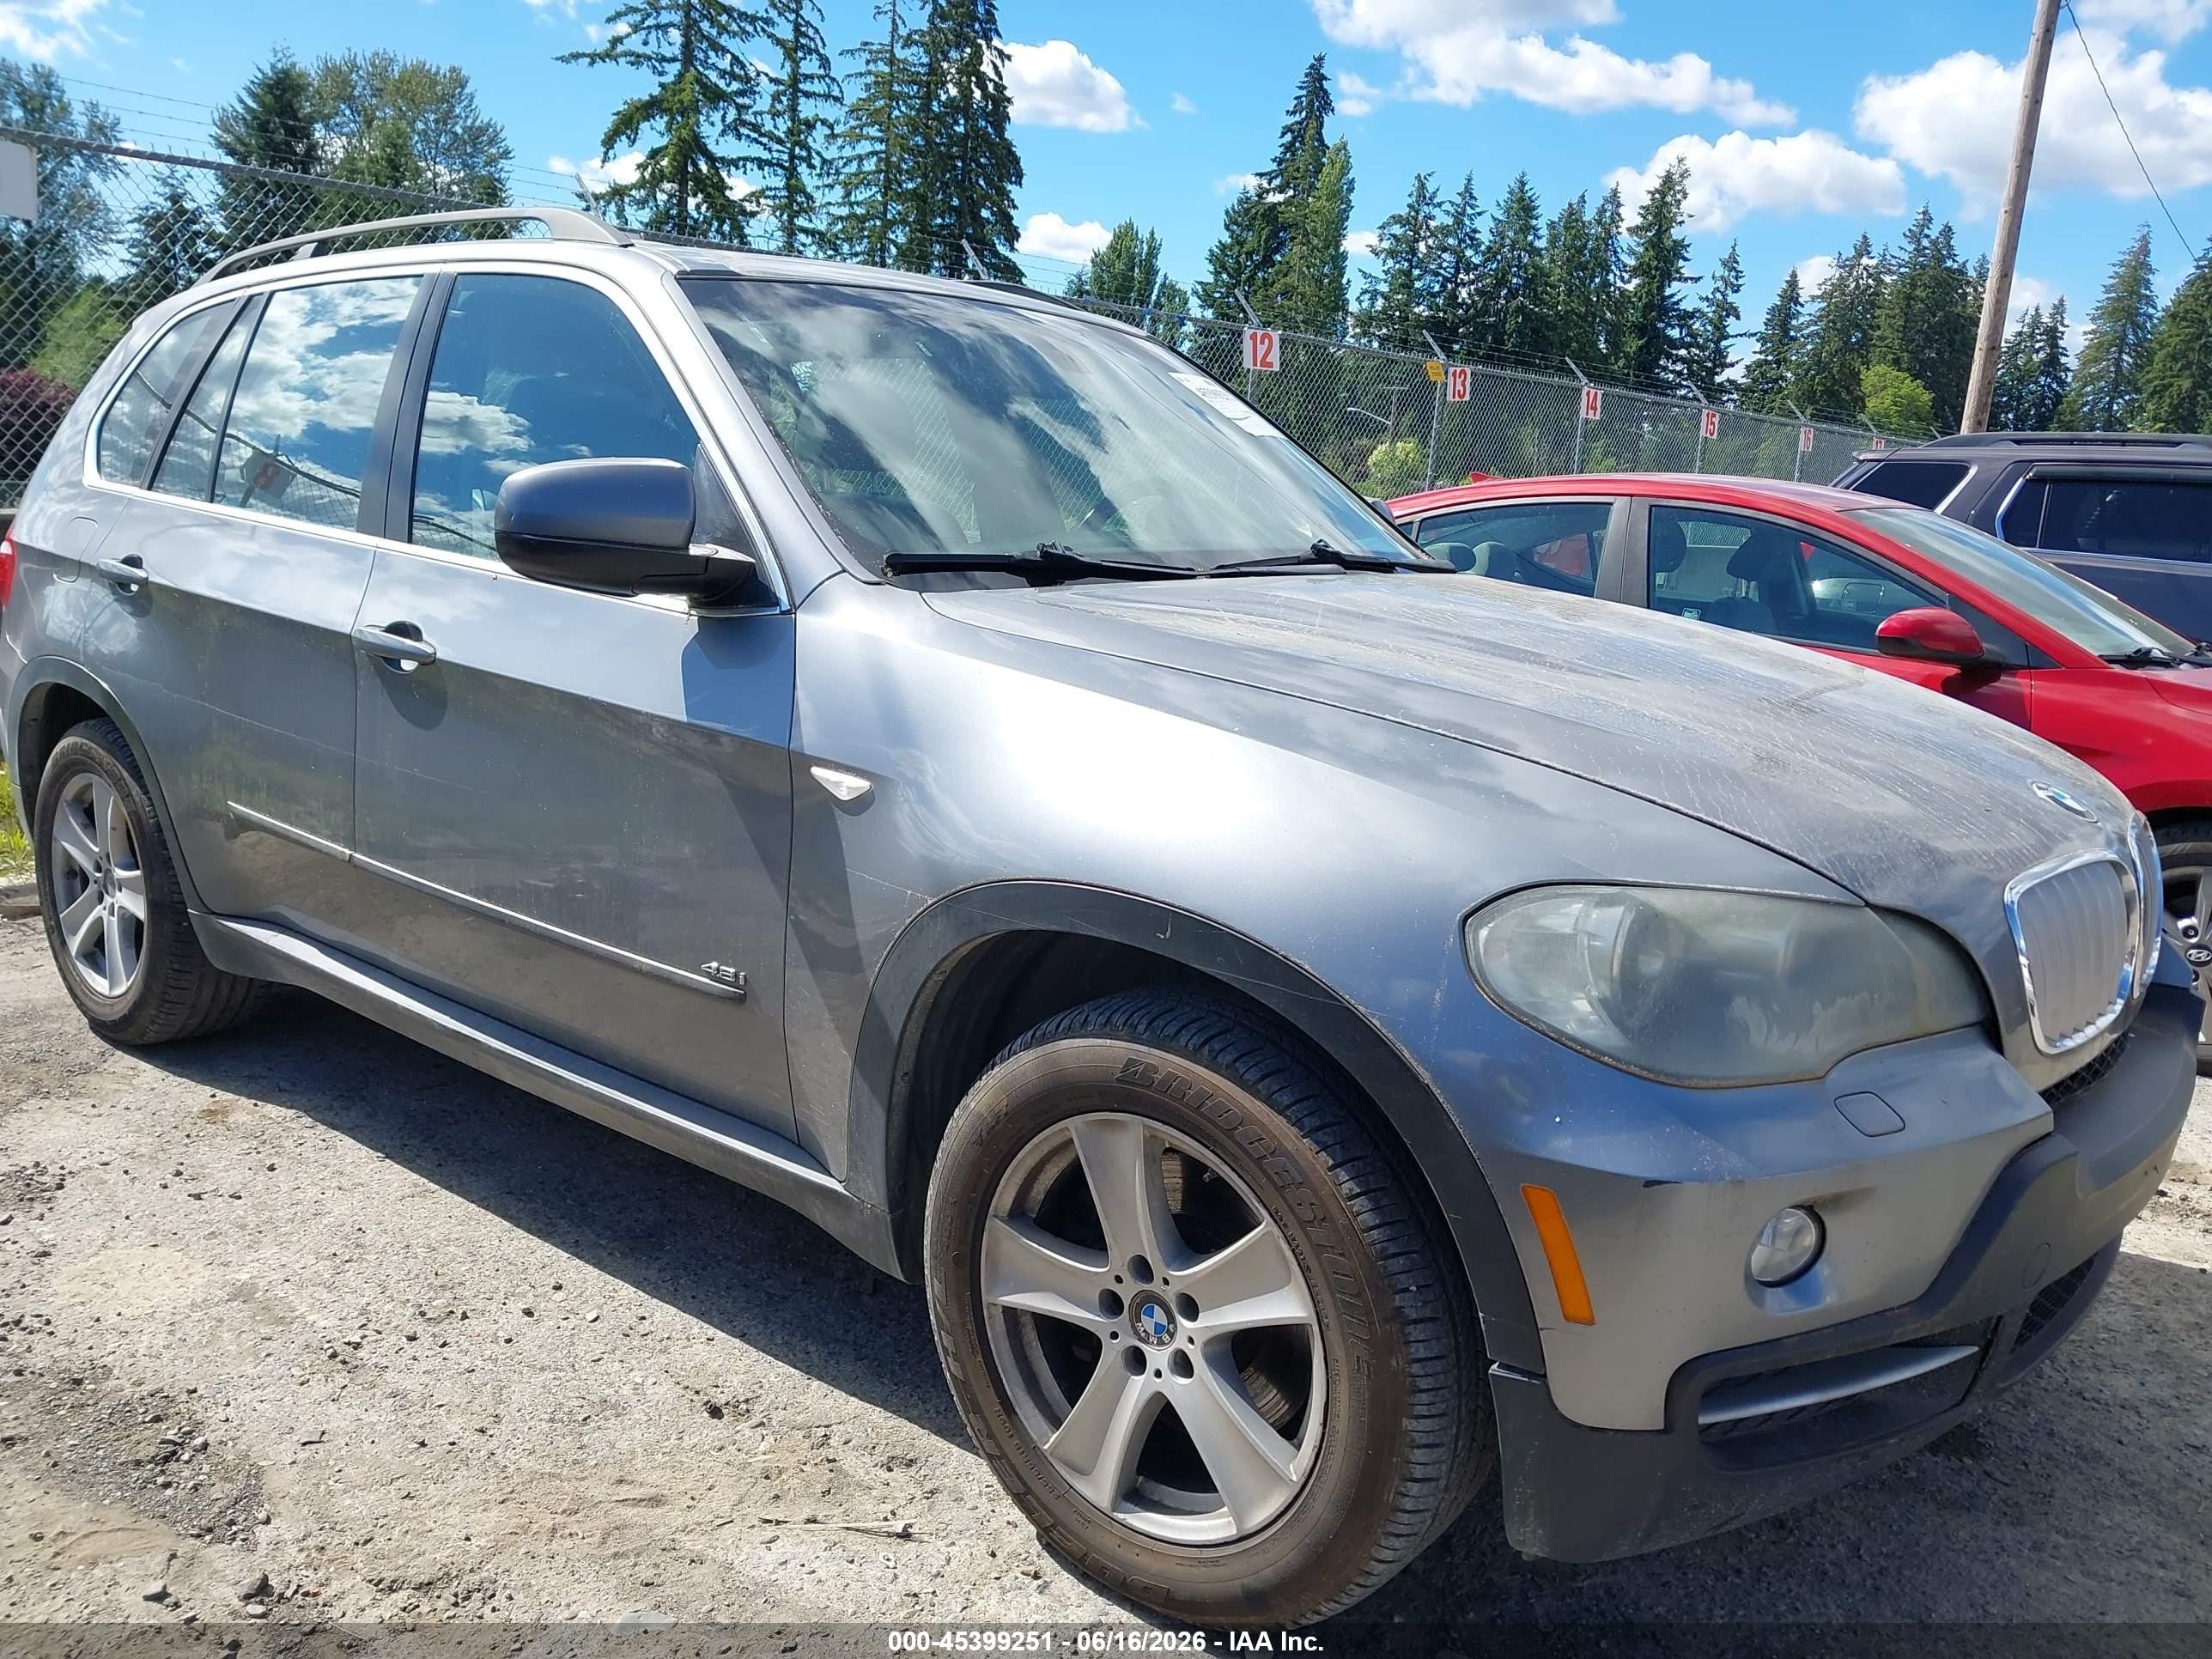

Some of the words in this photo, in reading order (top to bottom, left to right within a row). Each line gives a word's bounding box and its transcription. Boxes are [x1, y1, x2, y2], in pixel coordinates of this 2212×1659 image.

[1249, 331, 1274, 369] 12
[1451, 368, 1468, 399] 13
[1585, 390, 1598, 416] 14
[1705, 412, 1717, 436] 15
[1803, 429, 1811, 448] 16
[1114, 1056, 1378, 1384] BRIDGESTONE
[1135, 1322, 1171, 1345] BMW
